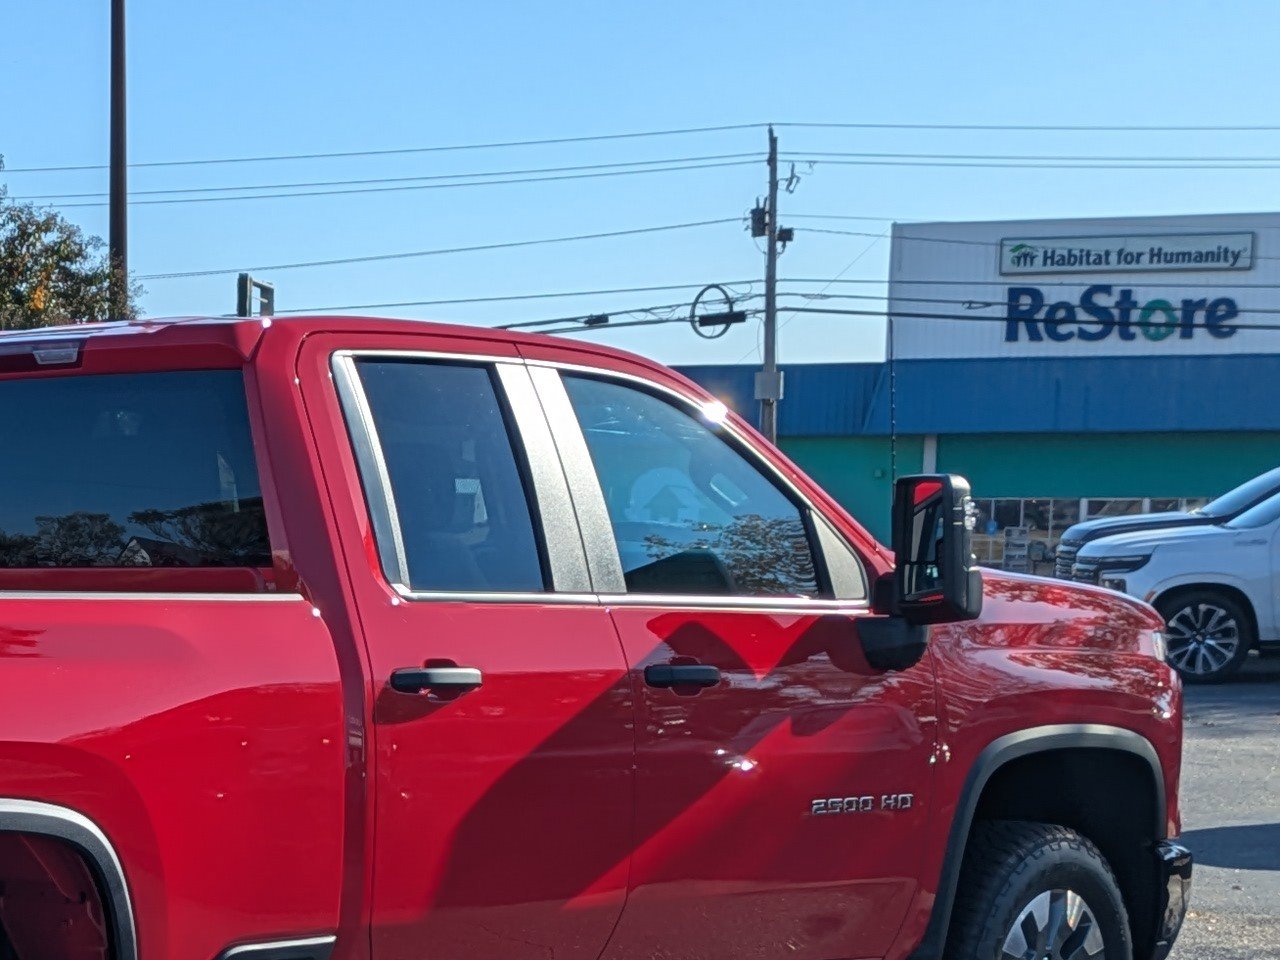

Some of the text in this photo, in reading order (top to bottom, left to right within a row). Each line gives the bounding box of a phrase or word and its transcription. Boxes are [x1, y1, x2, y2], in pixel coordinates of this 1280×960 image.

[1042, 245, 1243, 267] Habitat for Humanity
[1005, 285, 1239, 342] ReStore
[811, 793, 914, 816] 2500 HD
